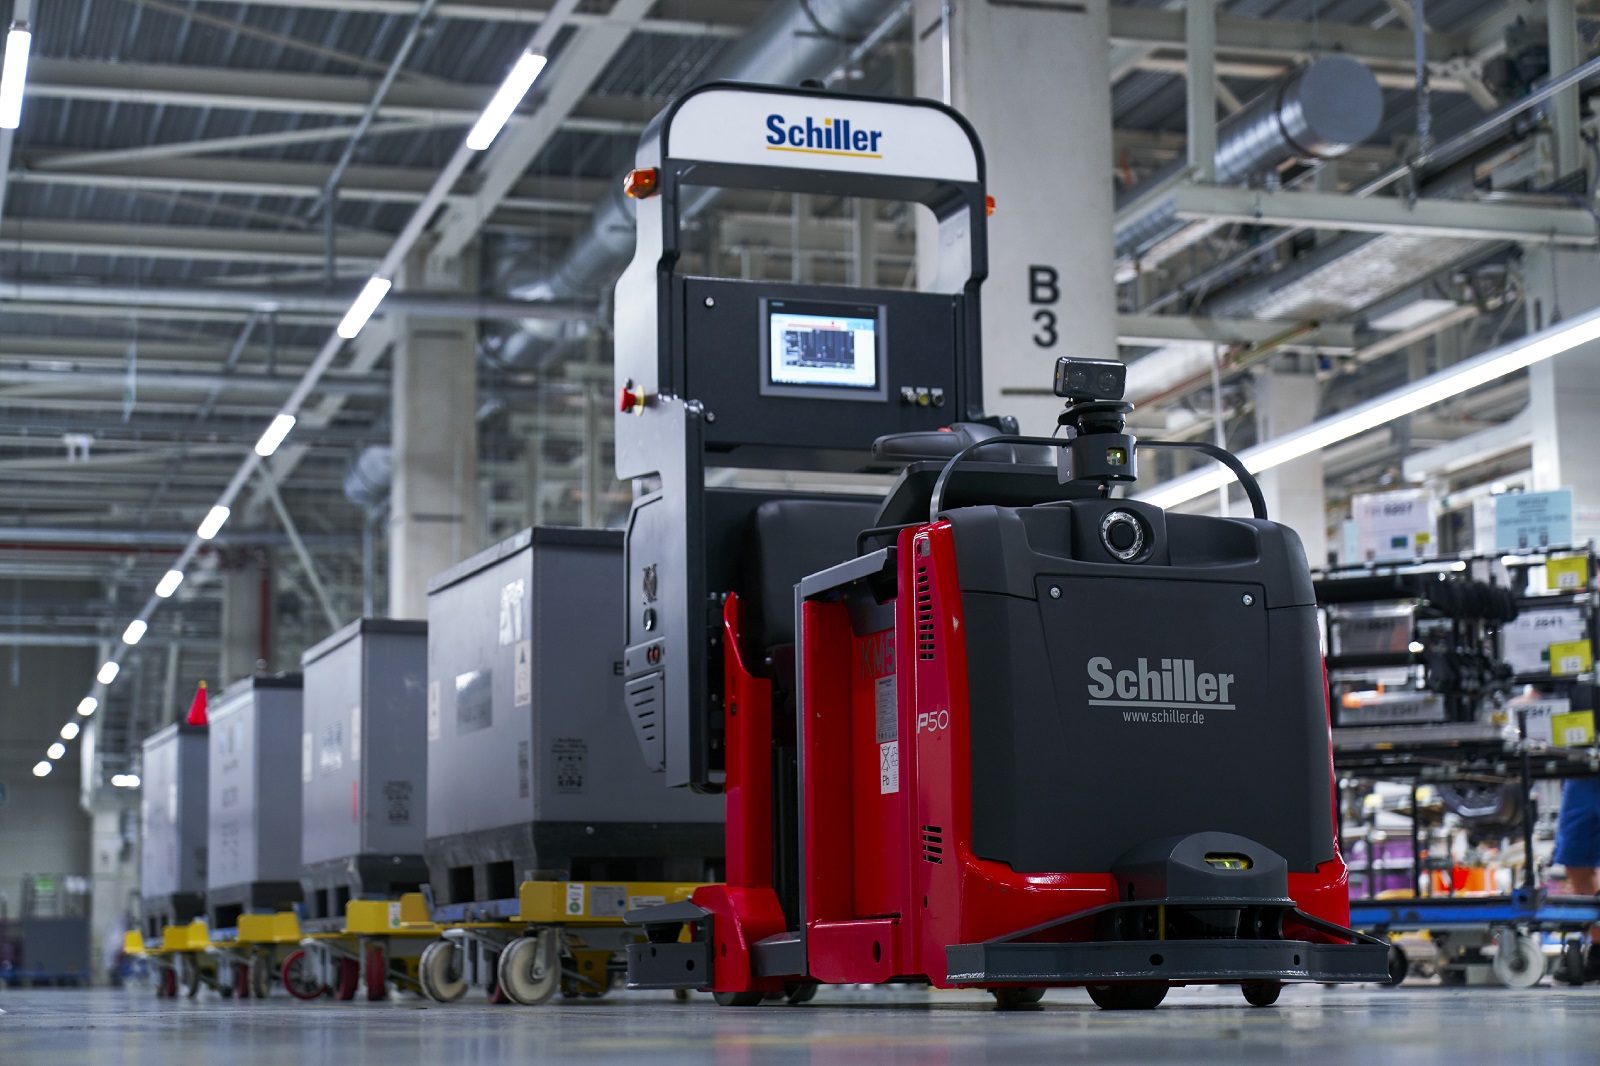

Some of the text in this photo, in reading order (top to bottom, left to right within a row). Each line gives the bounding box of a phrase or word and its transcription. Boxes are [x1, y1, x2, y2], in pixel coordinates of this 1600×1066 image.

[766, 114, 883, 153] Schiller
[1029, 264, 1060, 305] B
[1032, 308, 1058, 349] 3
[861, 632, 896, 680] KM5
[1087, 656, 1235, 702] Schiller
[917, 710, 949, 734] P50
[1122, 710, 1205, 724] www.schiller.de
